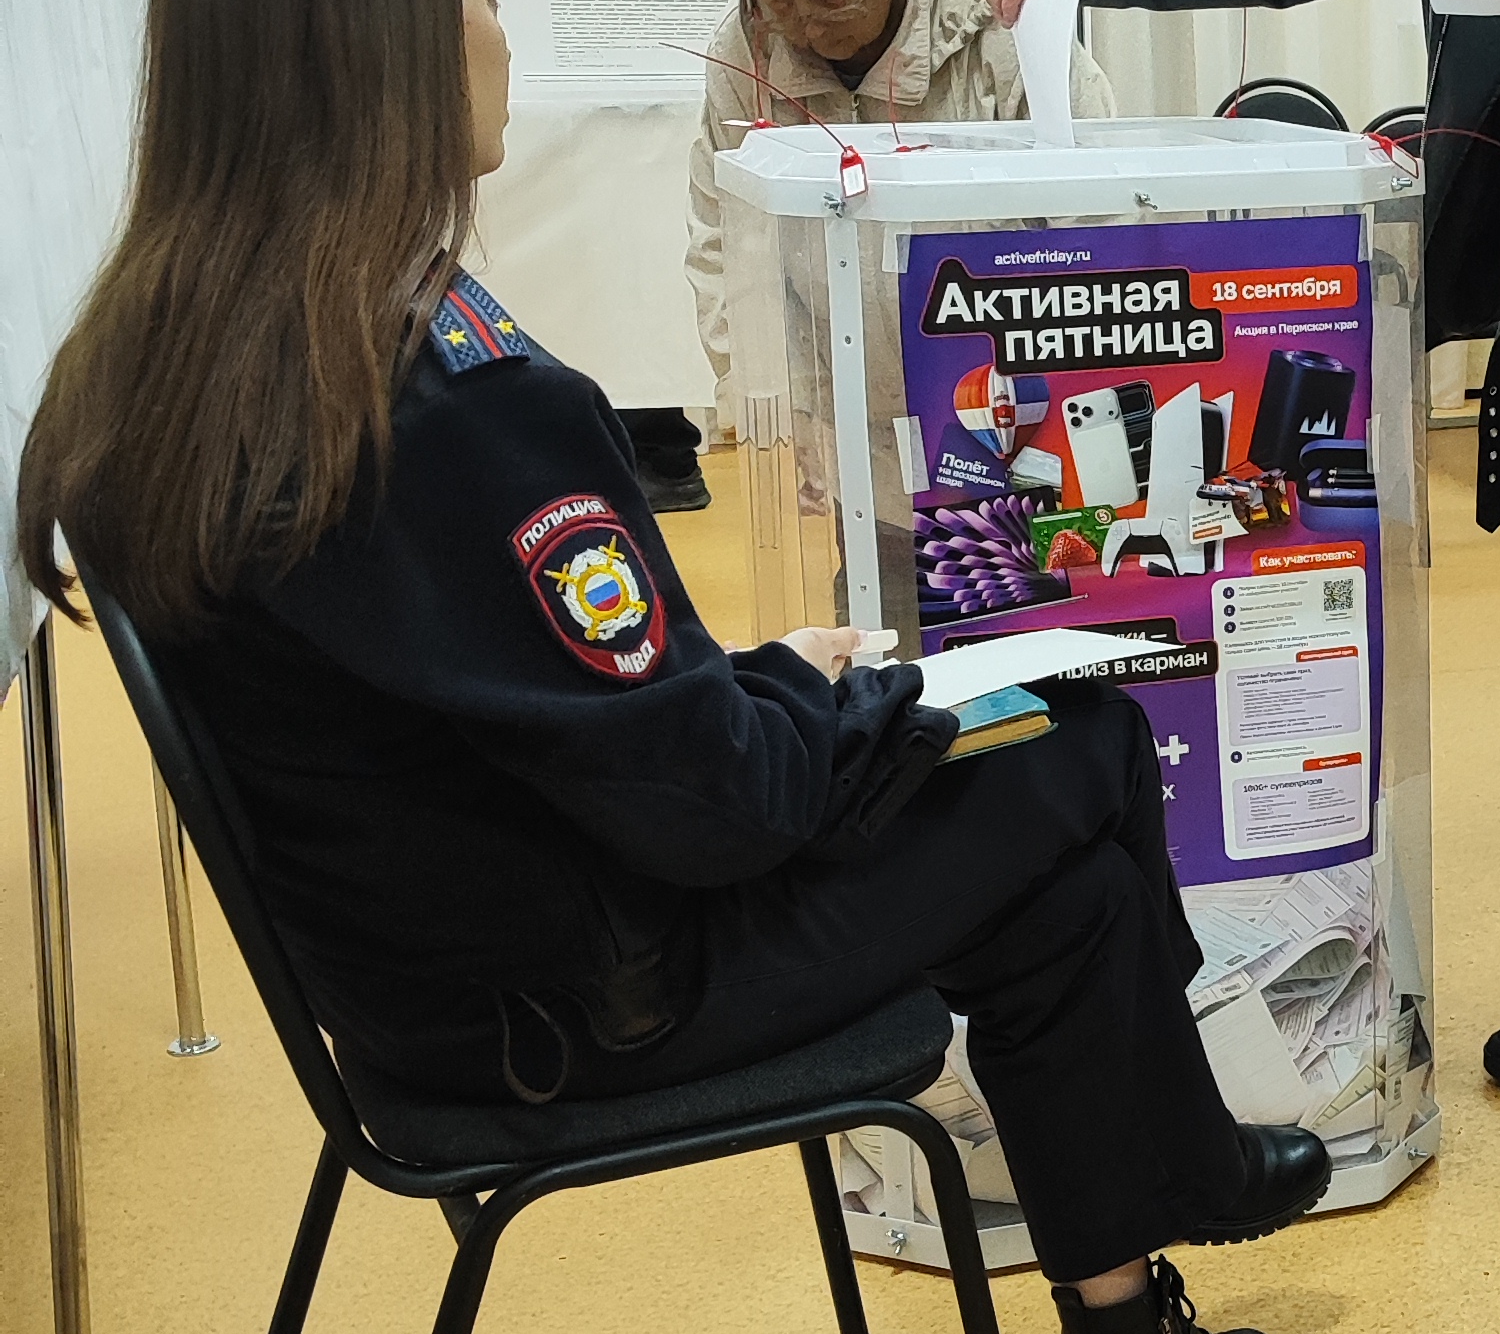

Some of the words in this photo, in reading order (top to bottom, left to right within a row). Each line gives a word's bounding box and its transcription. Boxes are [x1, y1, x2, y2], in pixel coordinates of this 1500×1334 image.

[994, 248, 1091, 266] activefriday.ru
[936, 279, 1180, 324] Активная
[1212, 281, 1238, 302] 18
[1241, 277, 1341, 301] сентября
[1004, 318, 1214, 362] пятница
[1234, 325, 1269, 338] Акция
[1279, 322, 1333, 335] Пермском
[1334, 320, 1359, 332] крае
[941, 452, 990, 476] Полёт
[520, 499, 607, 553] ПОЛИЦИЯ
[1259, 556, 1282, 568] Как
[613, 639, 657, 674] МВД
[1114, 660, 1126, 675] в
[1131, 652, 1208, 675] карман
